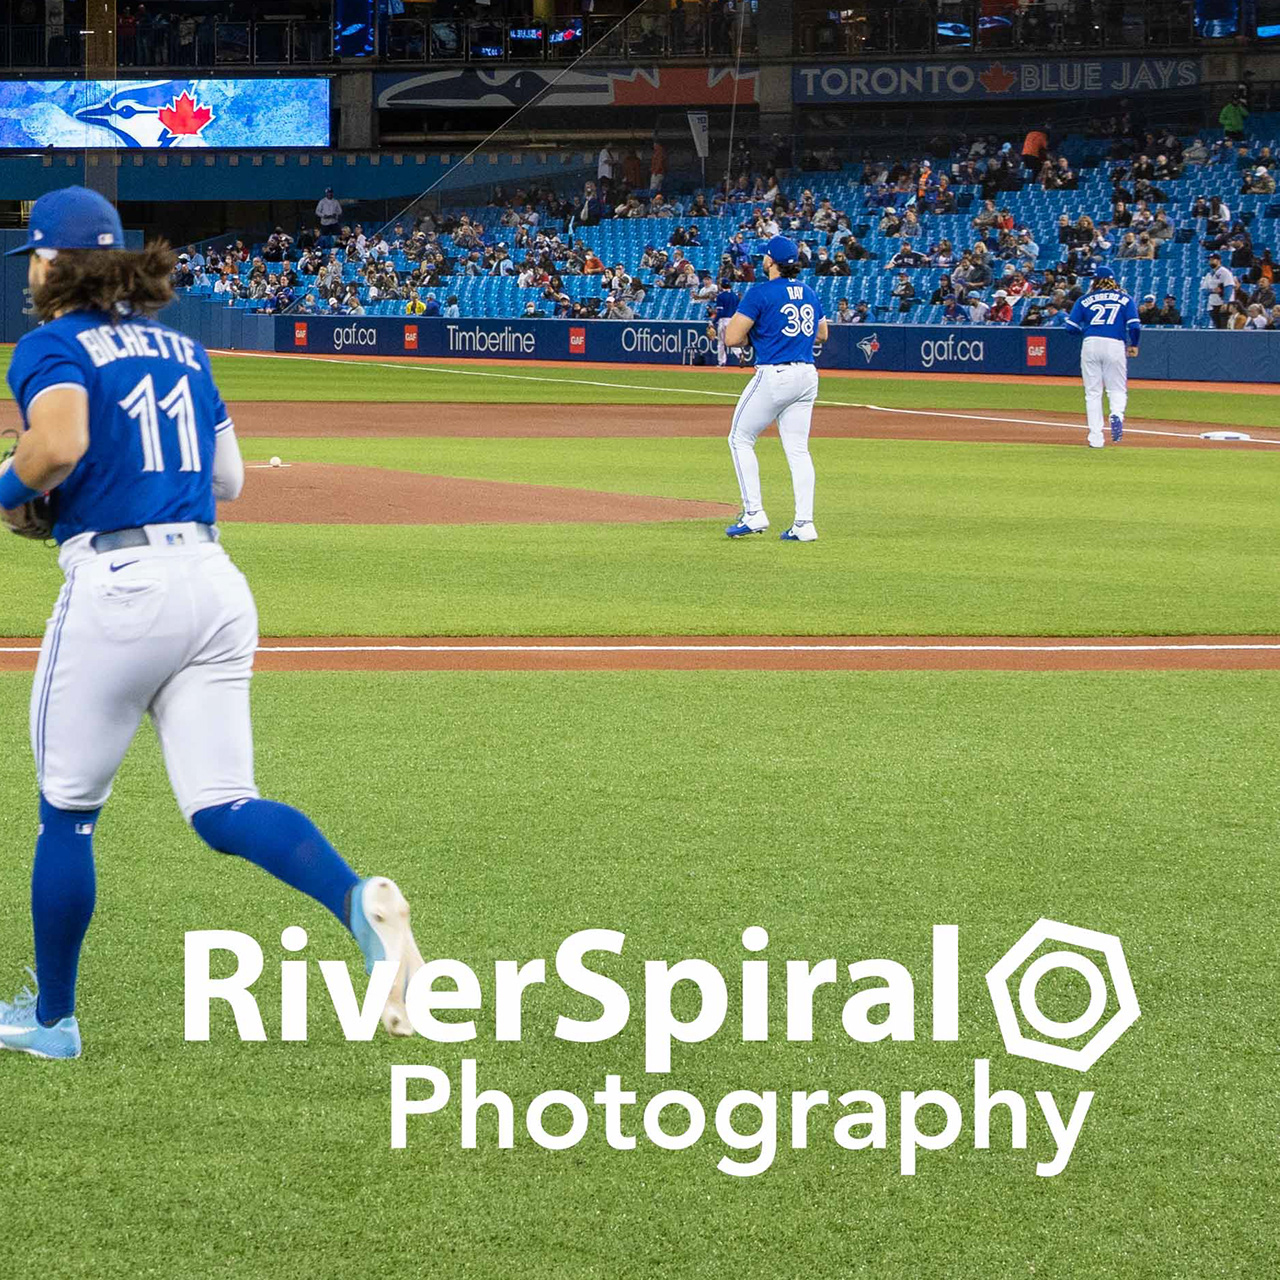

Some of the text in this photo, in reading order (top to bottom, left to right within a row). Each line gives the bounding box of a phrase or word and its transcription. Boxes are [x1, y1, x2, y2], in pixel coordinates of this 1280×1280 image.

[800, 59, 1197, 95] TORONTO BLUE JAYS
[787, 286, 803, 299] RAY
[780, 304, 814, 336] 38
[1089, 302, 1122, 326] 27
[76, 323, 202, 371] BICHETTE
[334, 324, 376, 350] gaf.ca
[447, 325, 535, 352] Timberline
[622, 328, 681, 353] Official
[921, 336, 983, 367] gaf.ca
[1028, 345, 1046, 357] GAF
[119, 374, 201, 472] 11
